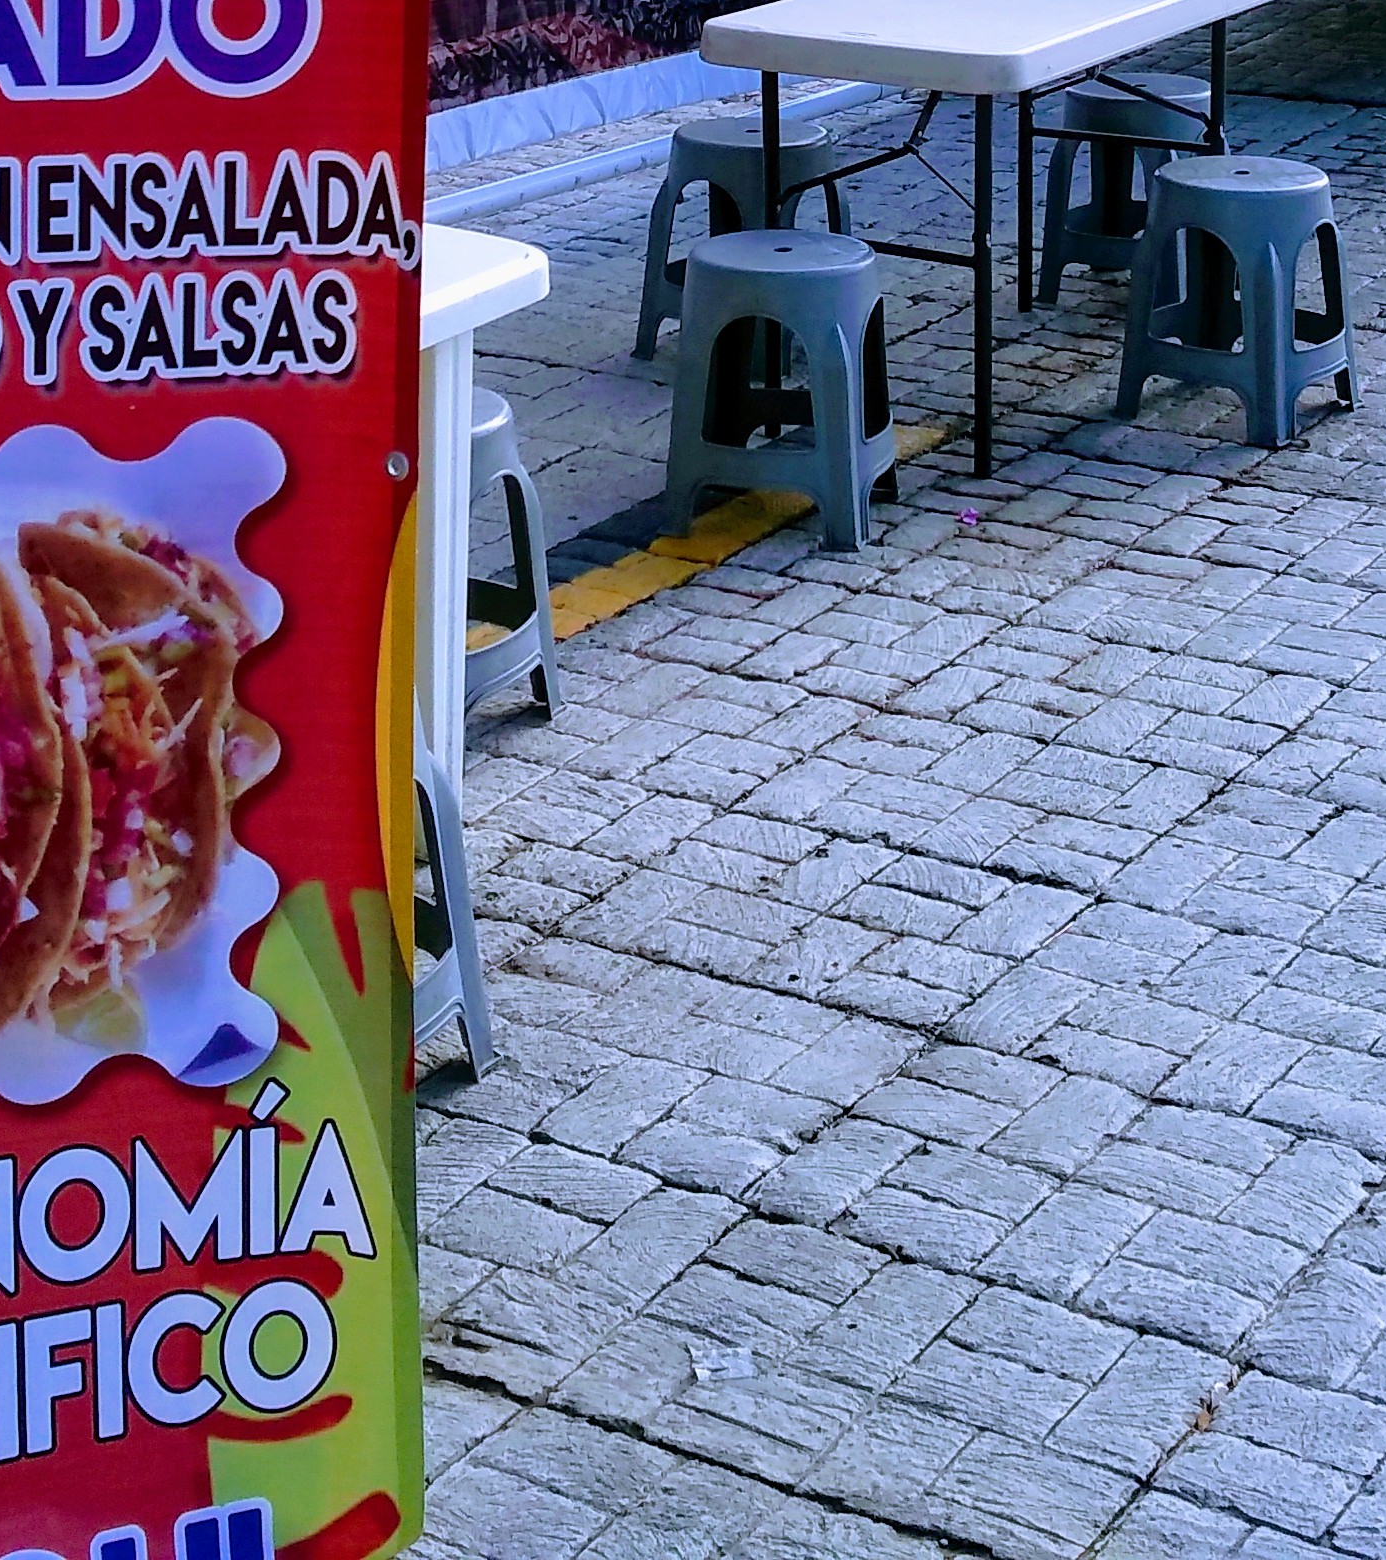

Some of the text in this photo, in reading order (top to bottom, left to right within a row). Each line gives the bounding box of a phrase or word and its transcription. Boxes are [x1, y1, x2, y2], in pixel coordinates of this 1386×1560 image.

[33, 149, 420, 268] ENSALADA,
[11, 278, 78, 385] Y
[80, 270, 357, 383] SALSAS
